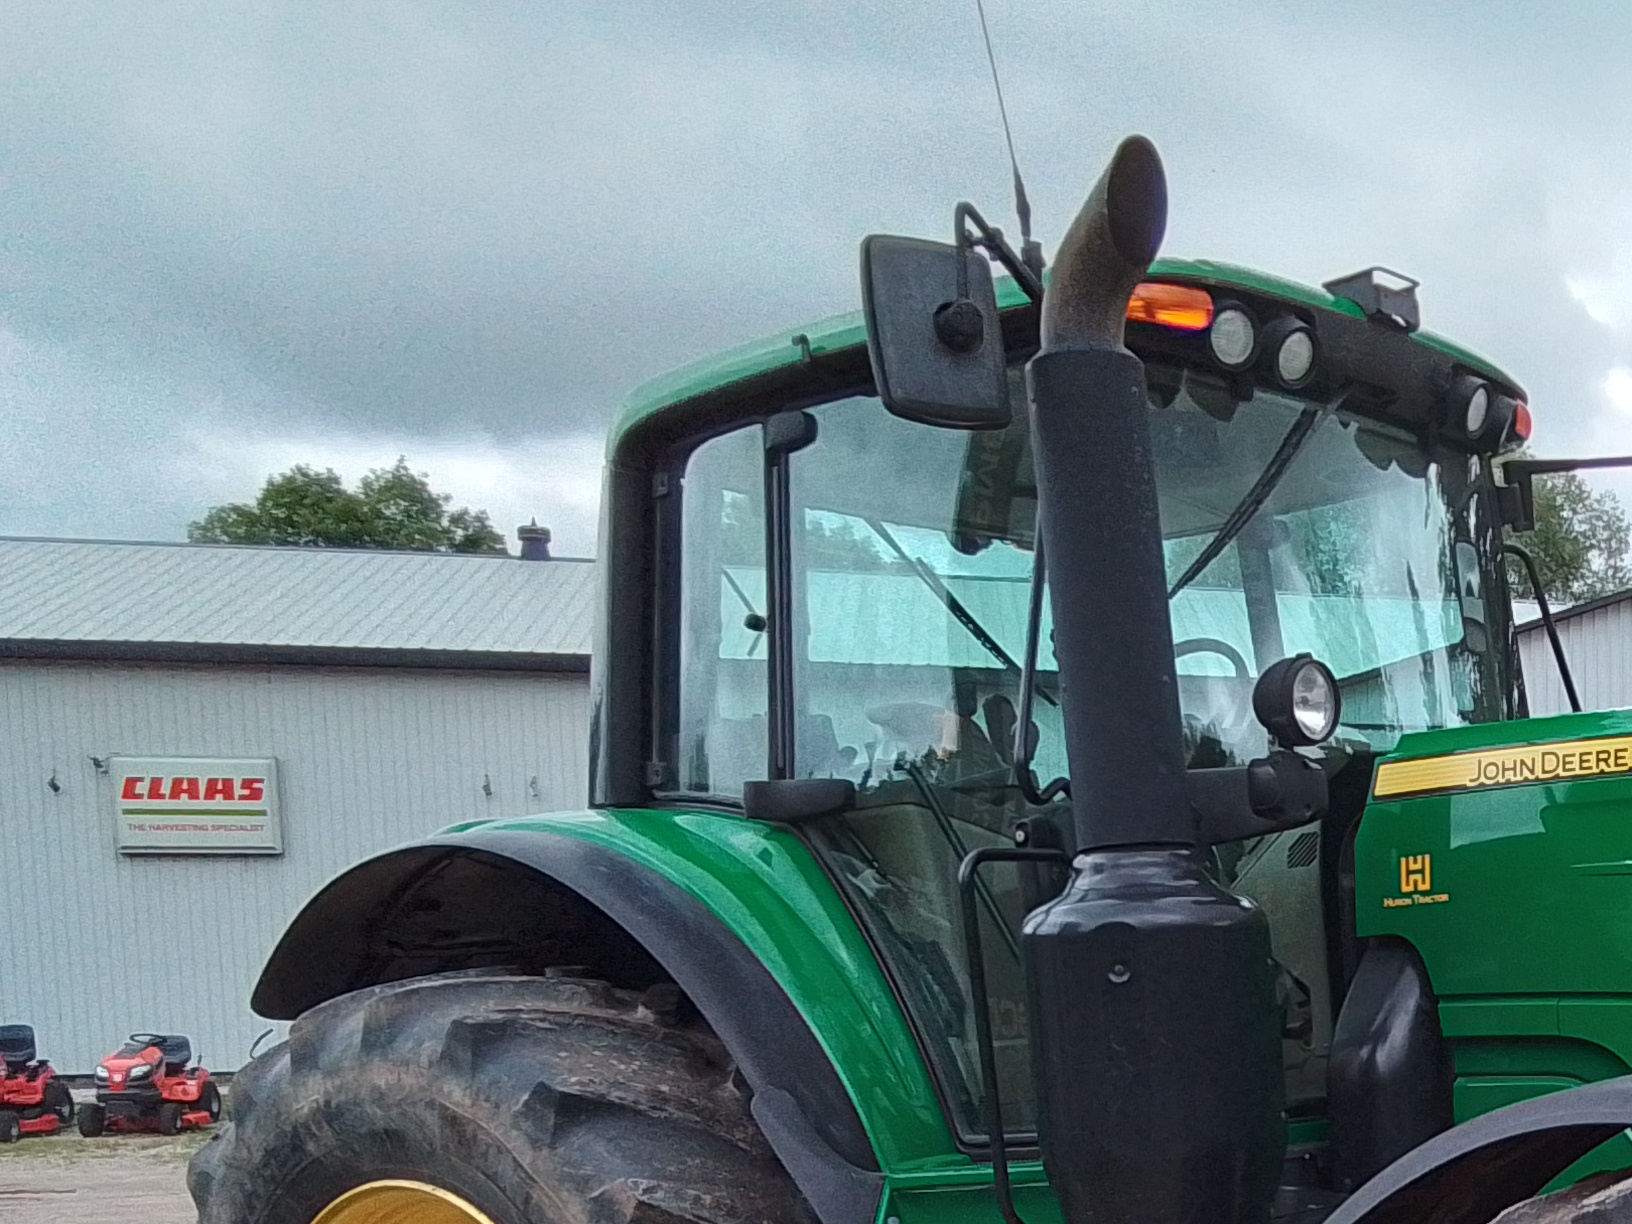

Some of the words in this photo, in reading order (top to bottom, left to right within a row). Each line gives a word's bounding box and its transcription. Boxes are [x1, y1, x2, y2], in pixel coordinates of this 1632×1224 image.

[1468, 757, 1536, 784] JOHN
[1540, 748, 1629, 775] DEERE
[121, 776, 266, 801] CLAAS
[127, 823, 146, 832] THE
[148, 823, 209, 832] HARVESTING
[211, 823, 266, 832] SPECIALIST
